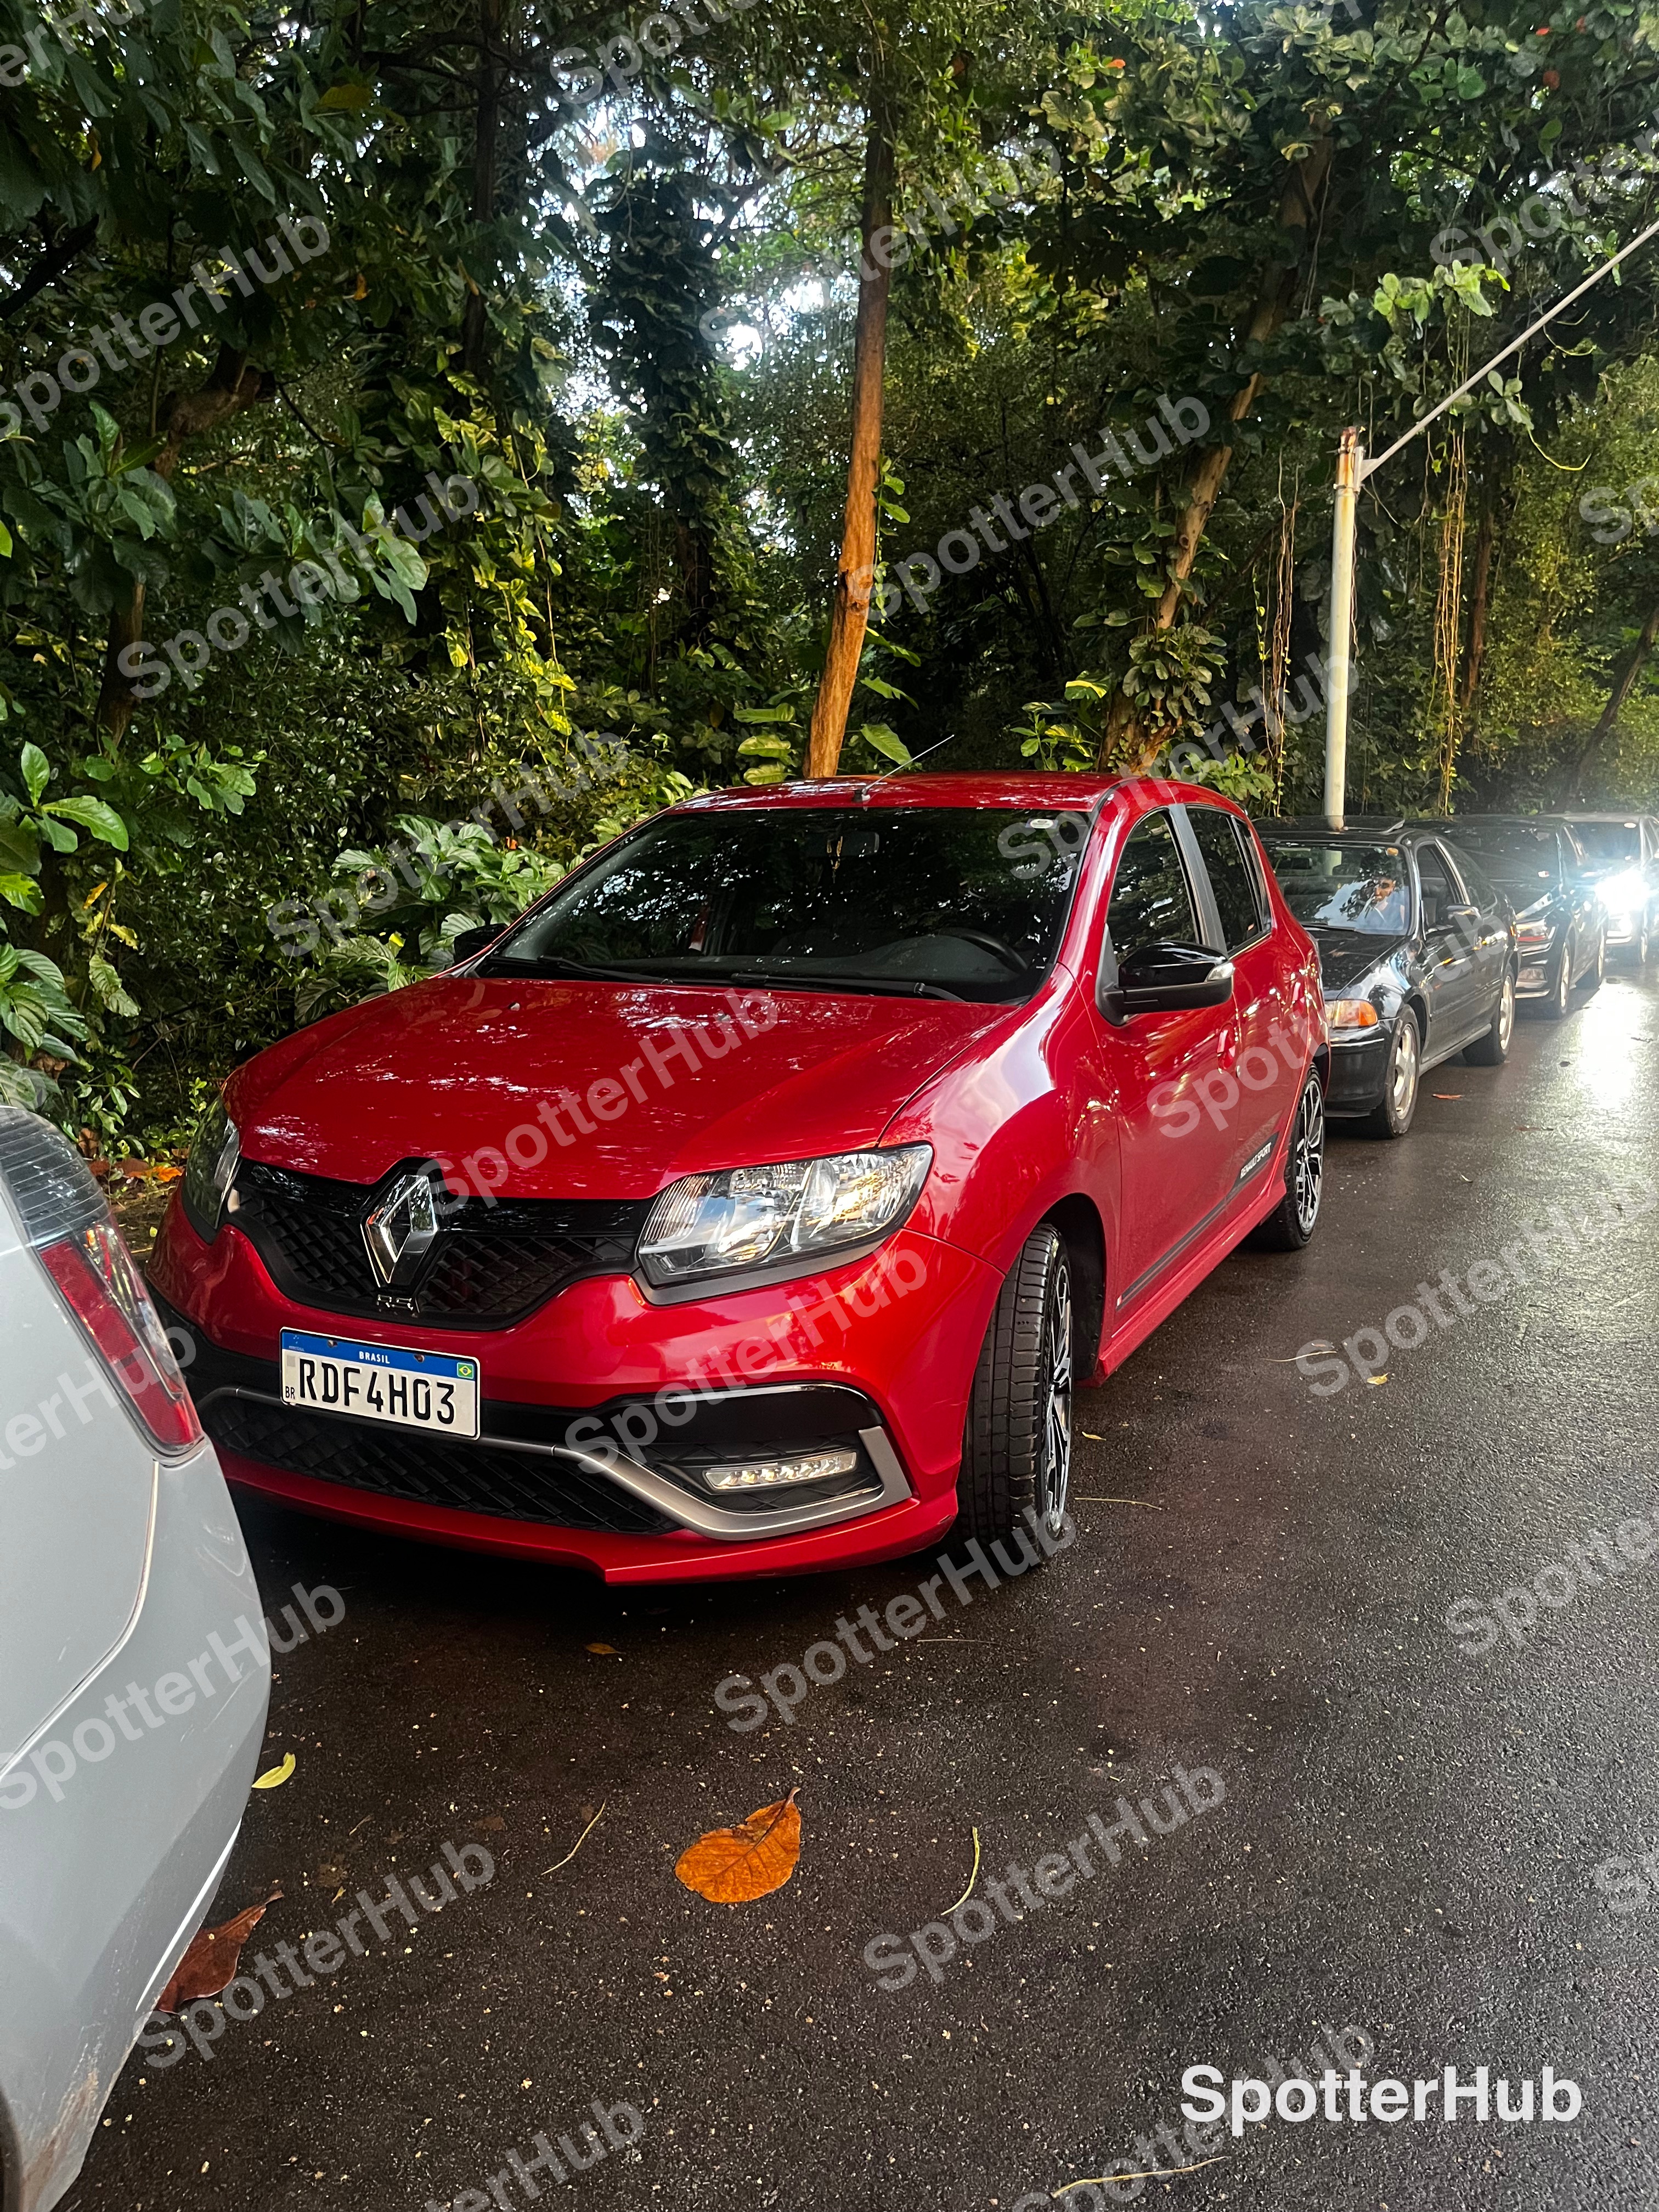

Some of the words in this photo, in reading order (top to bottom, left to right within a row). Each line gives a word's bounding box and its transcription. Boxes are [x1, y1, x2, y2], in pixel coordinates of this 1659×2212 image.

[359, 1351, 390, 1364] BRASIL
[285, 1386, 295, 1400] BR
[299, 1358, 455, 1424] RDF4H03
